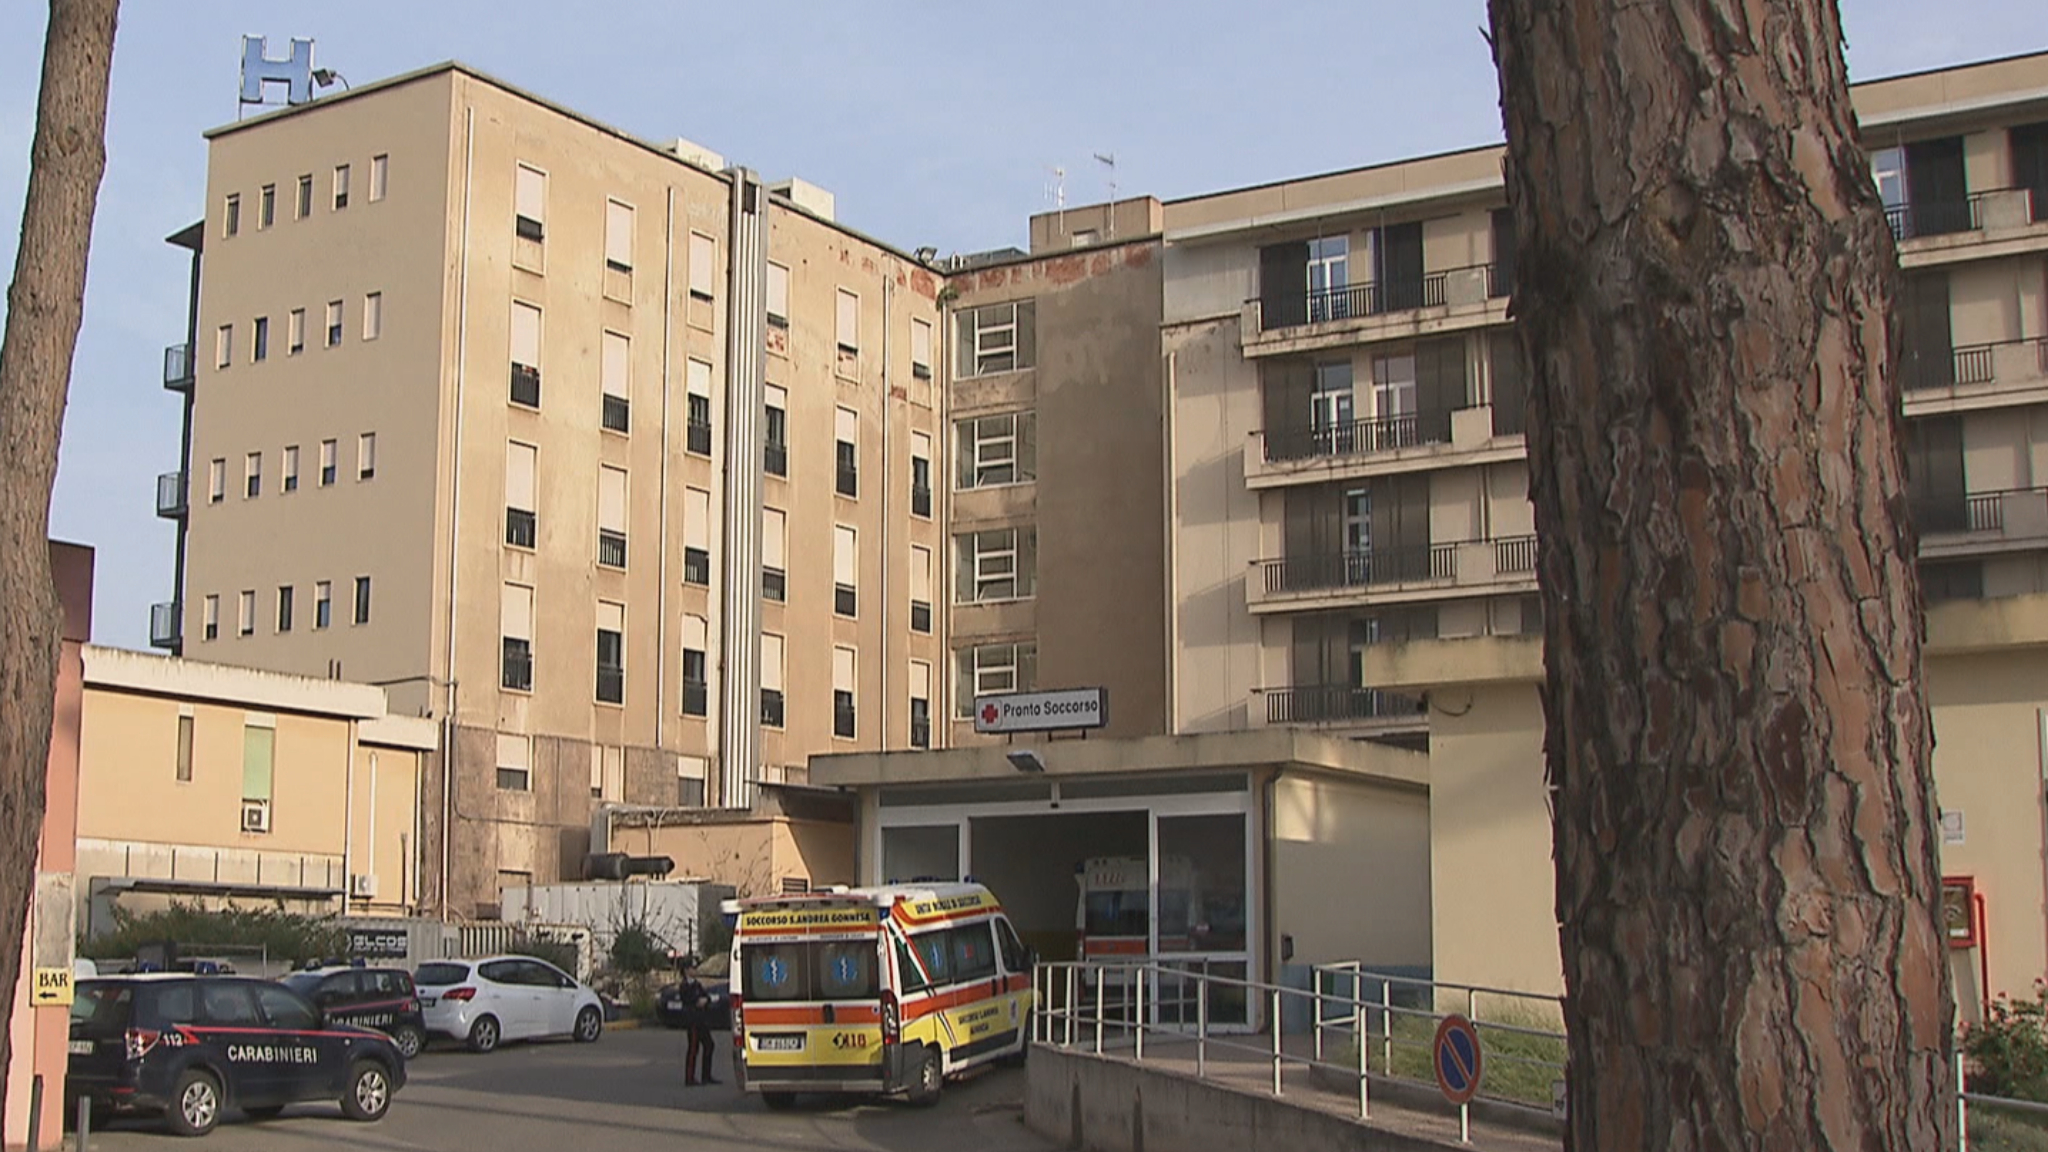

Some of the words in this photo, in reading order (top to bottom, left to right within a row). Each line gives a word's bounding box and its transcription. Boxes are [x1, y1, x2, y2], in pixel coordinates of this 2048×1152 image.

[241, 34, 314, 105] H
[1003, 703, 1041, 717] Pronto
[1044, 700, 1098, 715] Soccorso
[746, 915, 788, 926] SOCCORSO
[39, 973, 68, 987] BAR
[162, 1033, 184, 1047] 112
[227, 1044, 318, 1063] CARABINIERI
